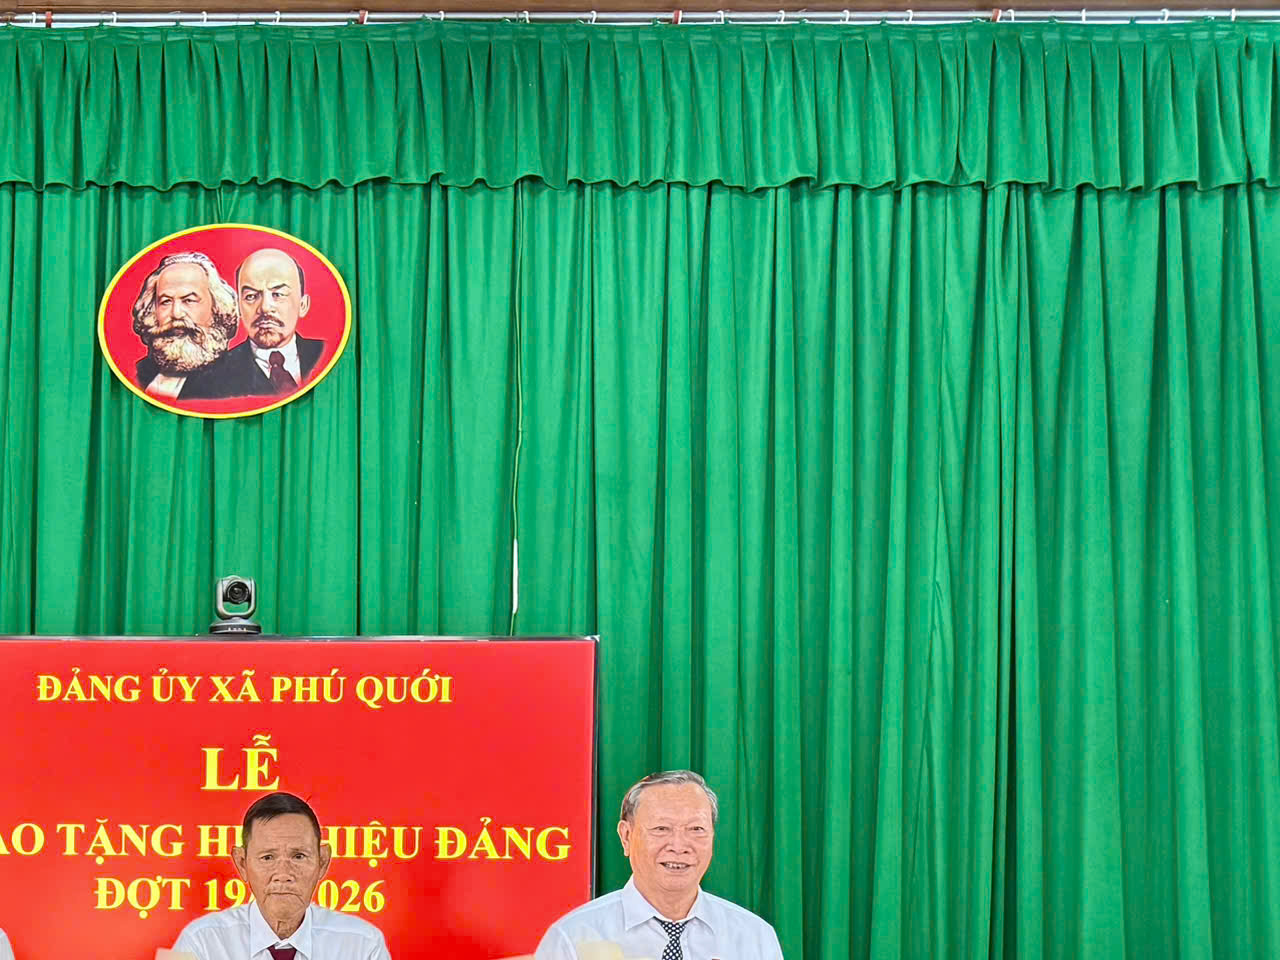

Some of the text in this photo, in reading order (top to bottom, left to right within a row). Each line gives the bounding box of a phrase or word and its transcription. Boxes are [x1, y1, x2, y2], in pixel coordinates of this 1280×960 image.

[36, 667, 453, 709] ĐẢNG ỦY XÃ PHÚ QUỚI
[201, 734, 280, 791] LỄ
[56, 818, 185, 865] TẶNG
[434, 816, 572, 861] ĐẢNG
[94, 875, 191, 919] ĐỢT
